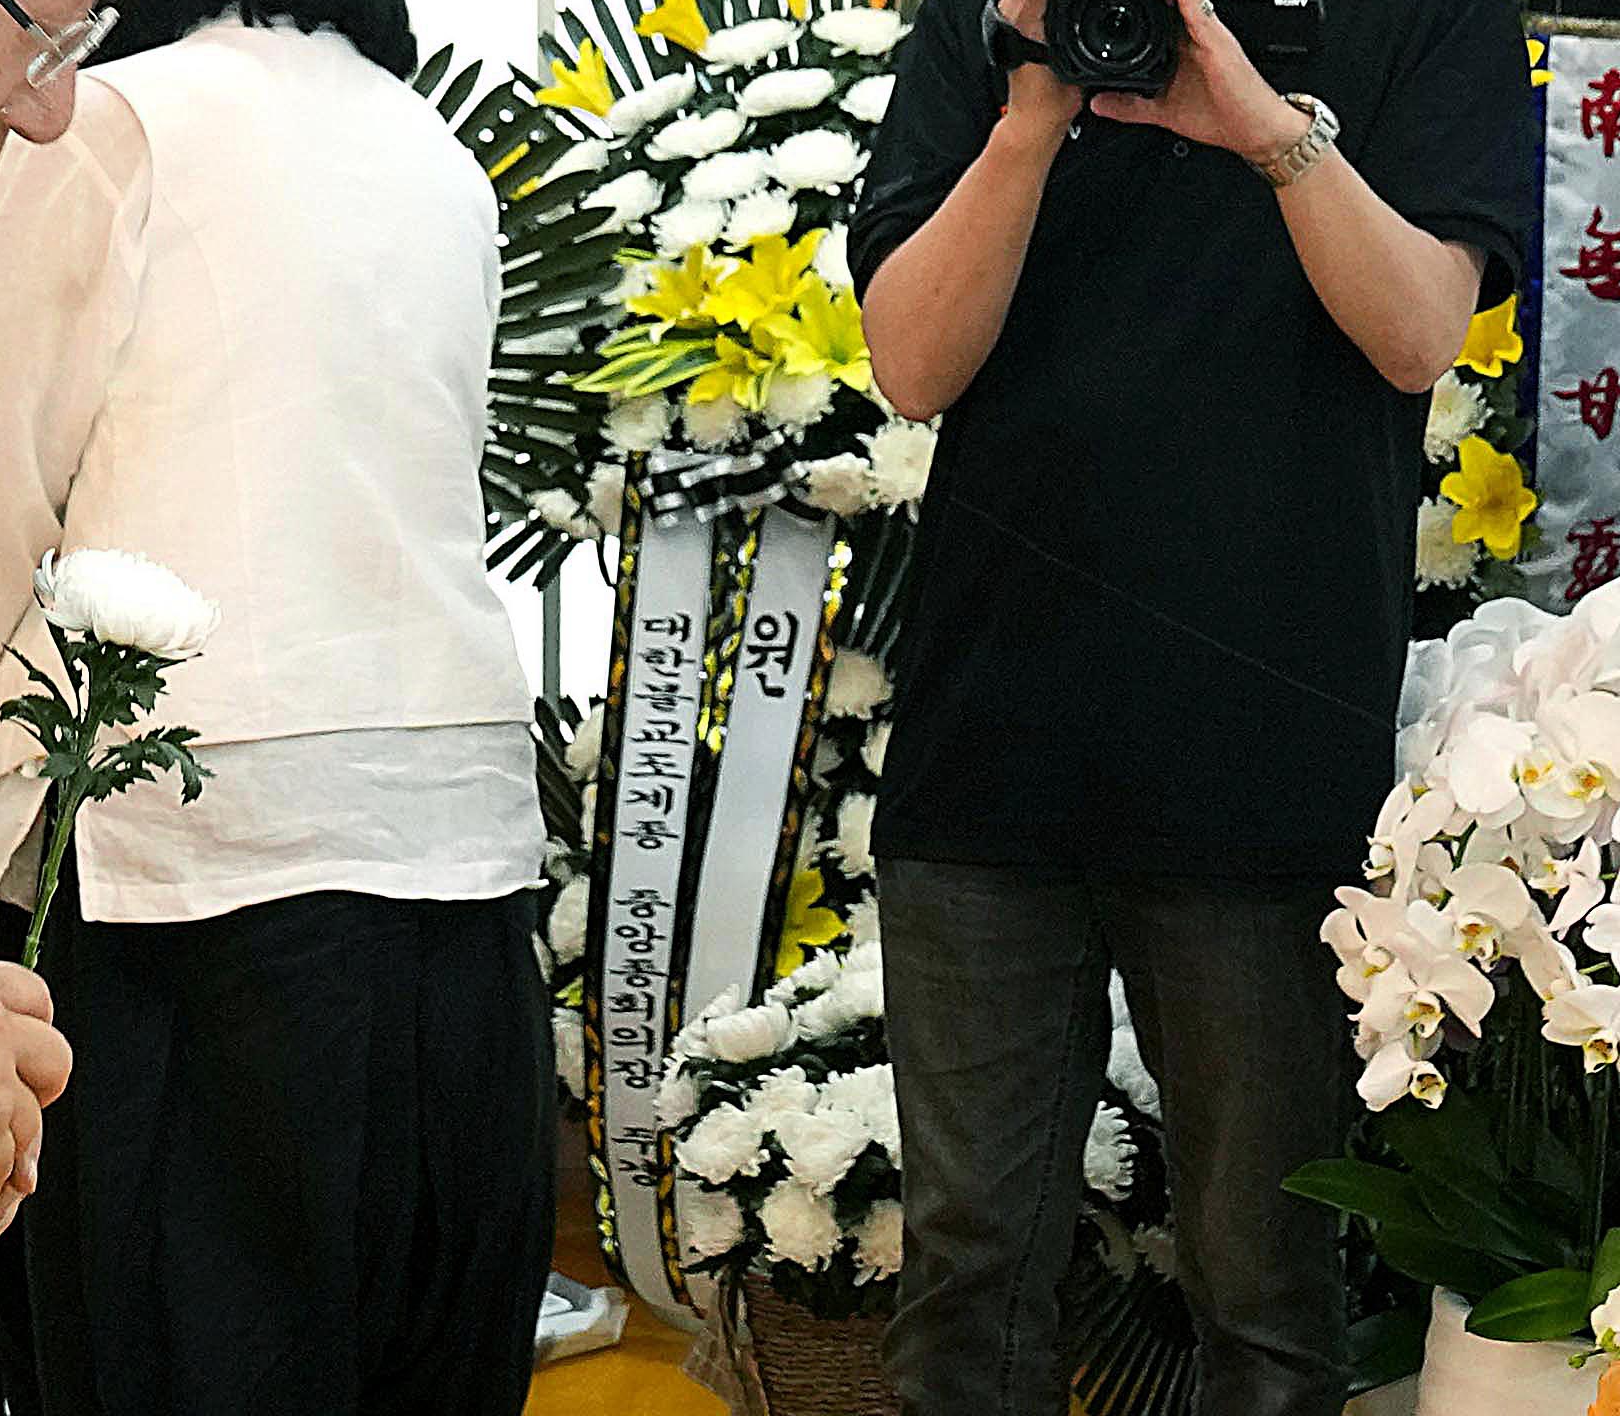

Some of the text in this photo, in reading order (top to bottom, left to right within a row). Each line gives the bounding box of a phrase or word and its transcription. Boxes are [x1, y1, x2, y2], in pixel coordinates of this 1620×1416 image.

[617, 612, 696, 850] 대한불교조계종
[746, 611, 798, 697] 원
[609, 888, 673, 1089] 중앙종회의장
